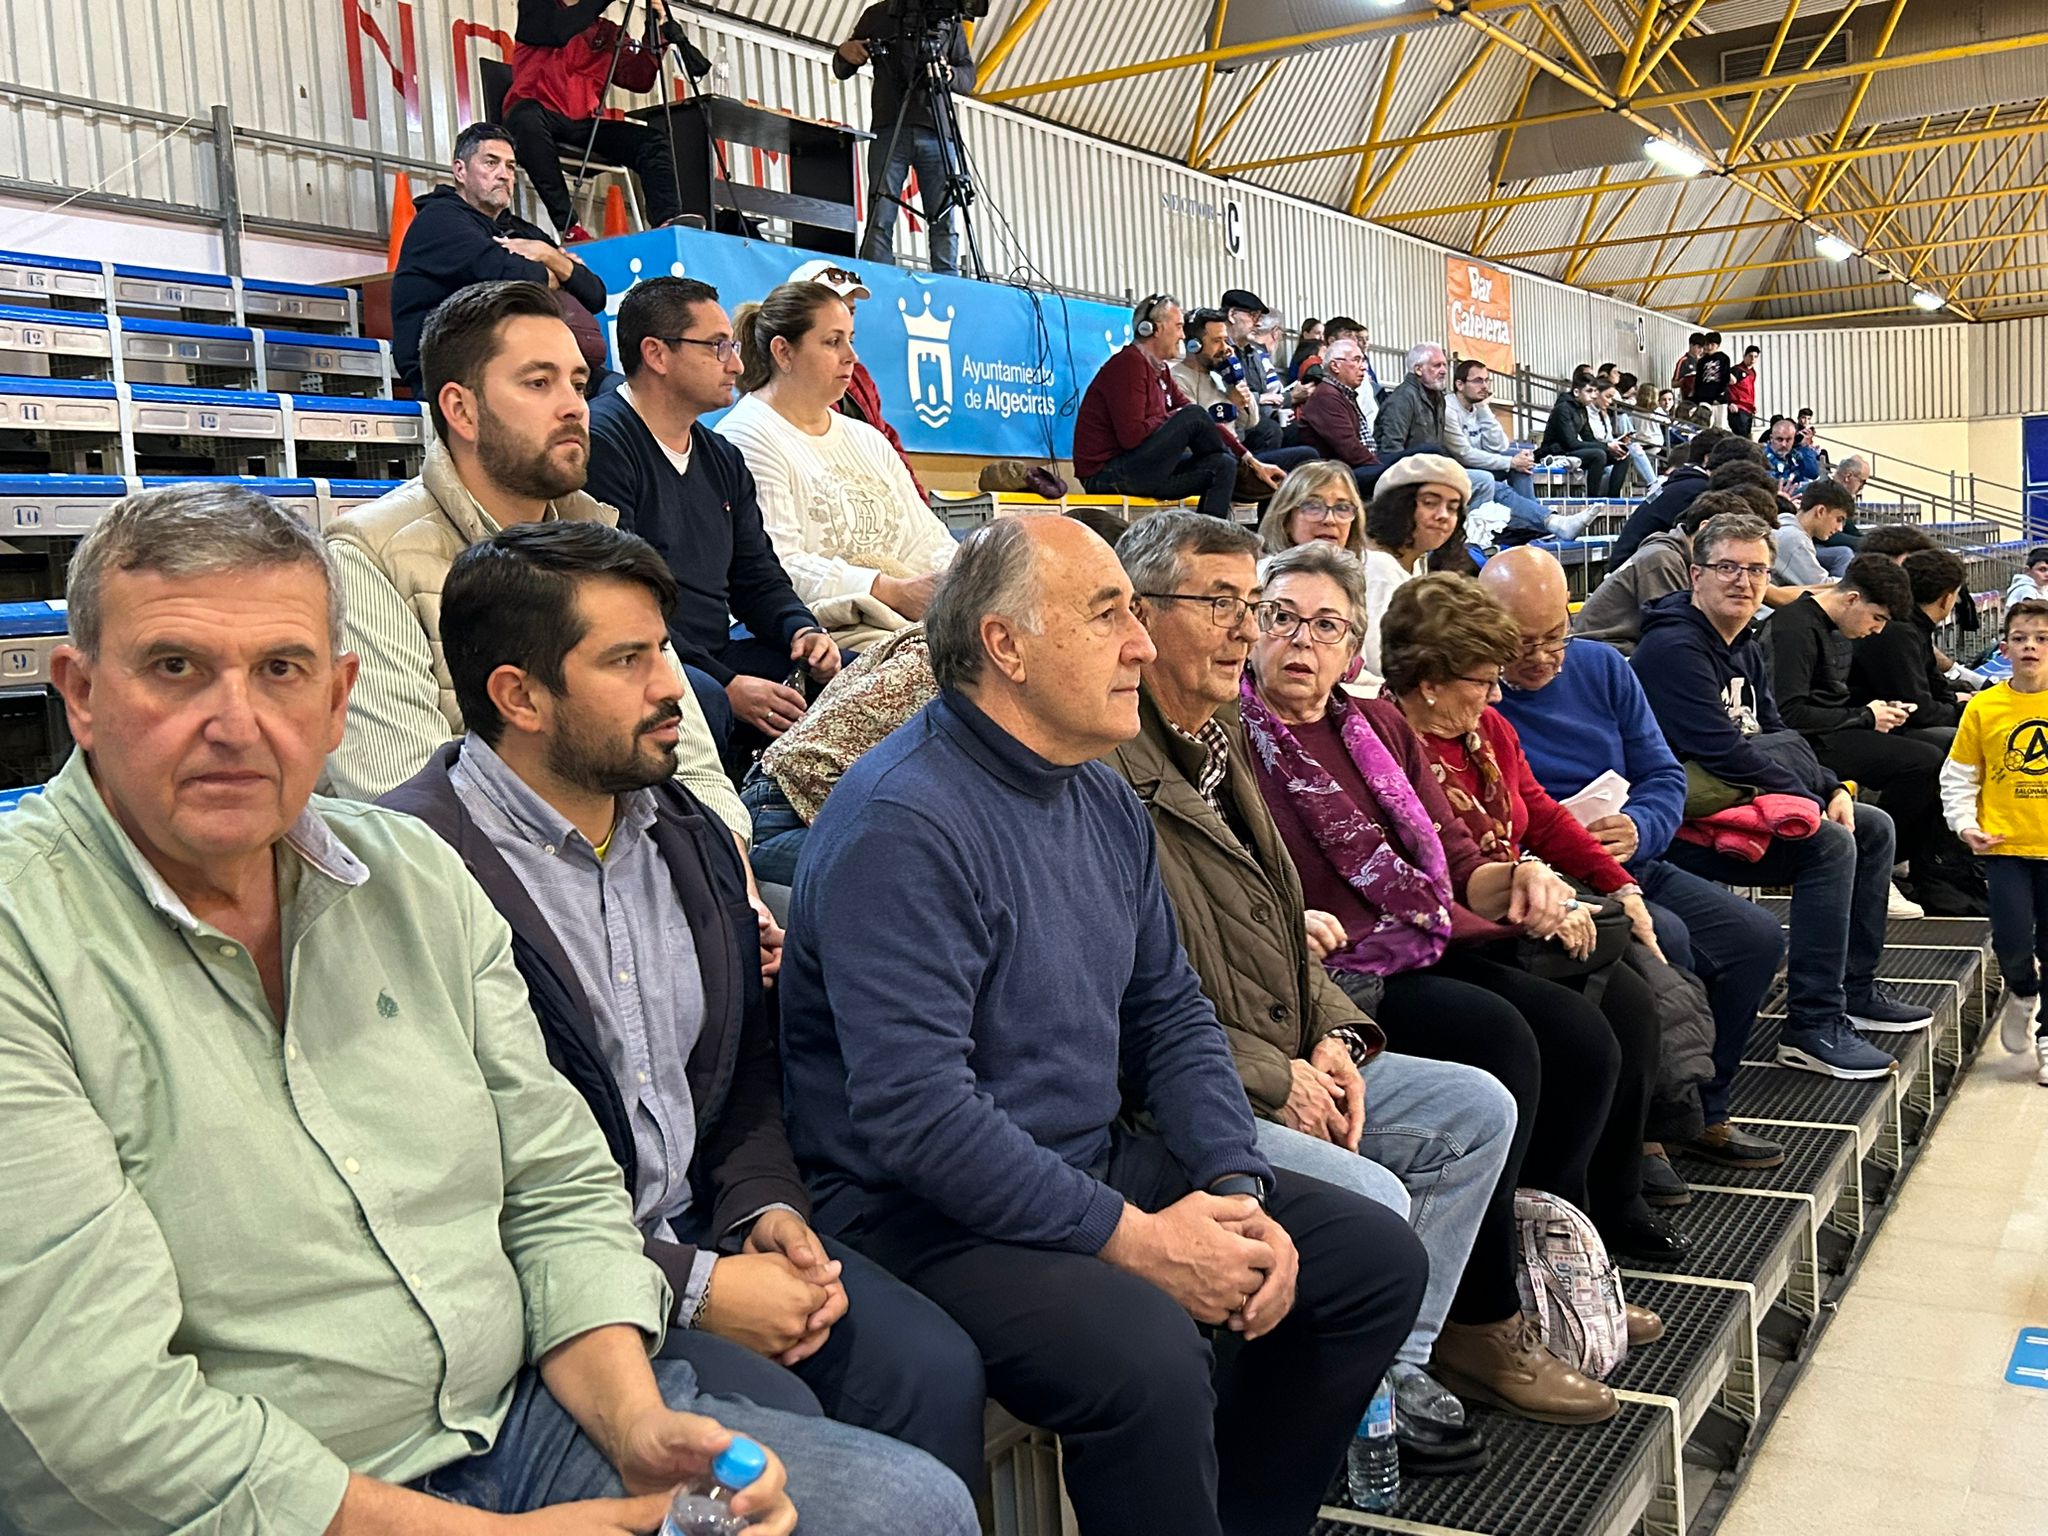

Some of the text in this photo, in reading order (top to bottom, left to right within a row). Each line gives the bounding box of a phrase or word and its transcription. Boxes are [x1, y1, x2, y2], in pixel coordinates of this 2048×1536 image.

[1228, 202, 1240, 254] C
[168, 289, 183, 300] 16
[1467, 266, 1493, 303] Bar
[26, 332, 41, 345] 12
[962, 354, 1055, 387] Ayuntamiento
[964, 384, 1056, 418] de Algeciras
[17, 508, 39, 525] 10
